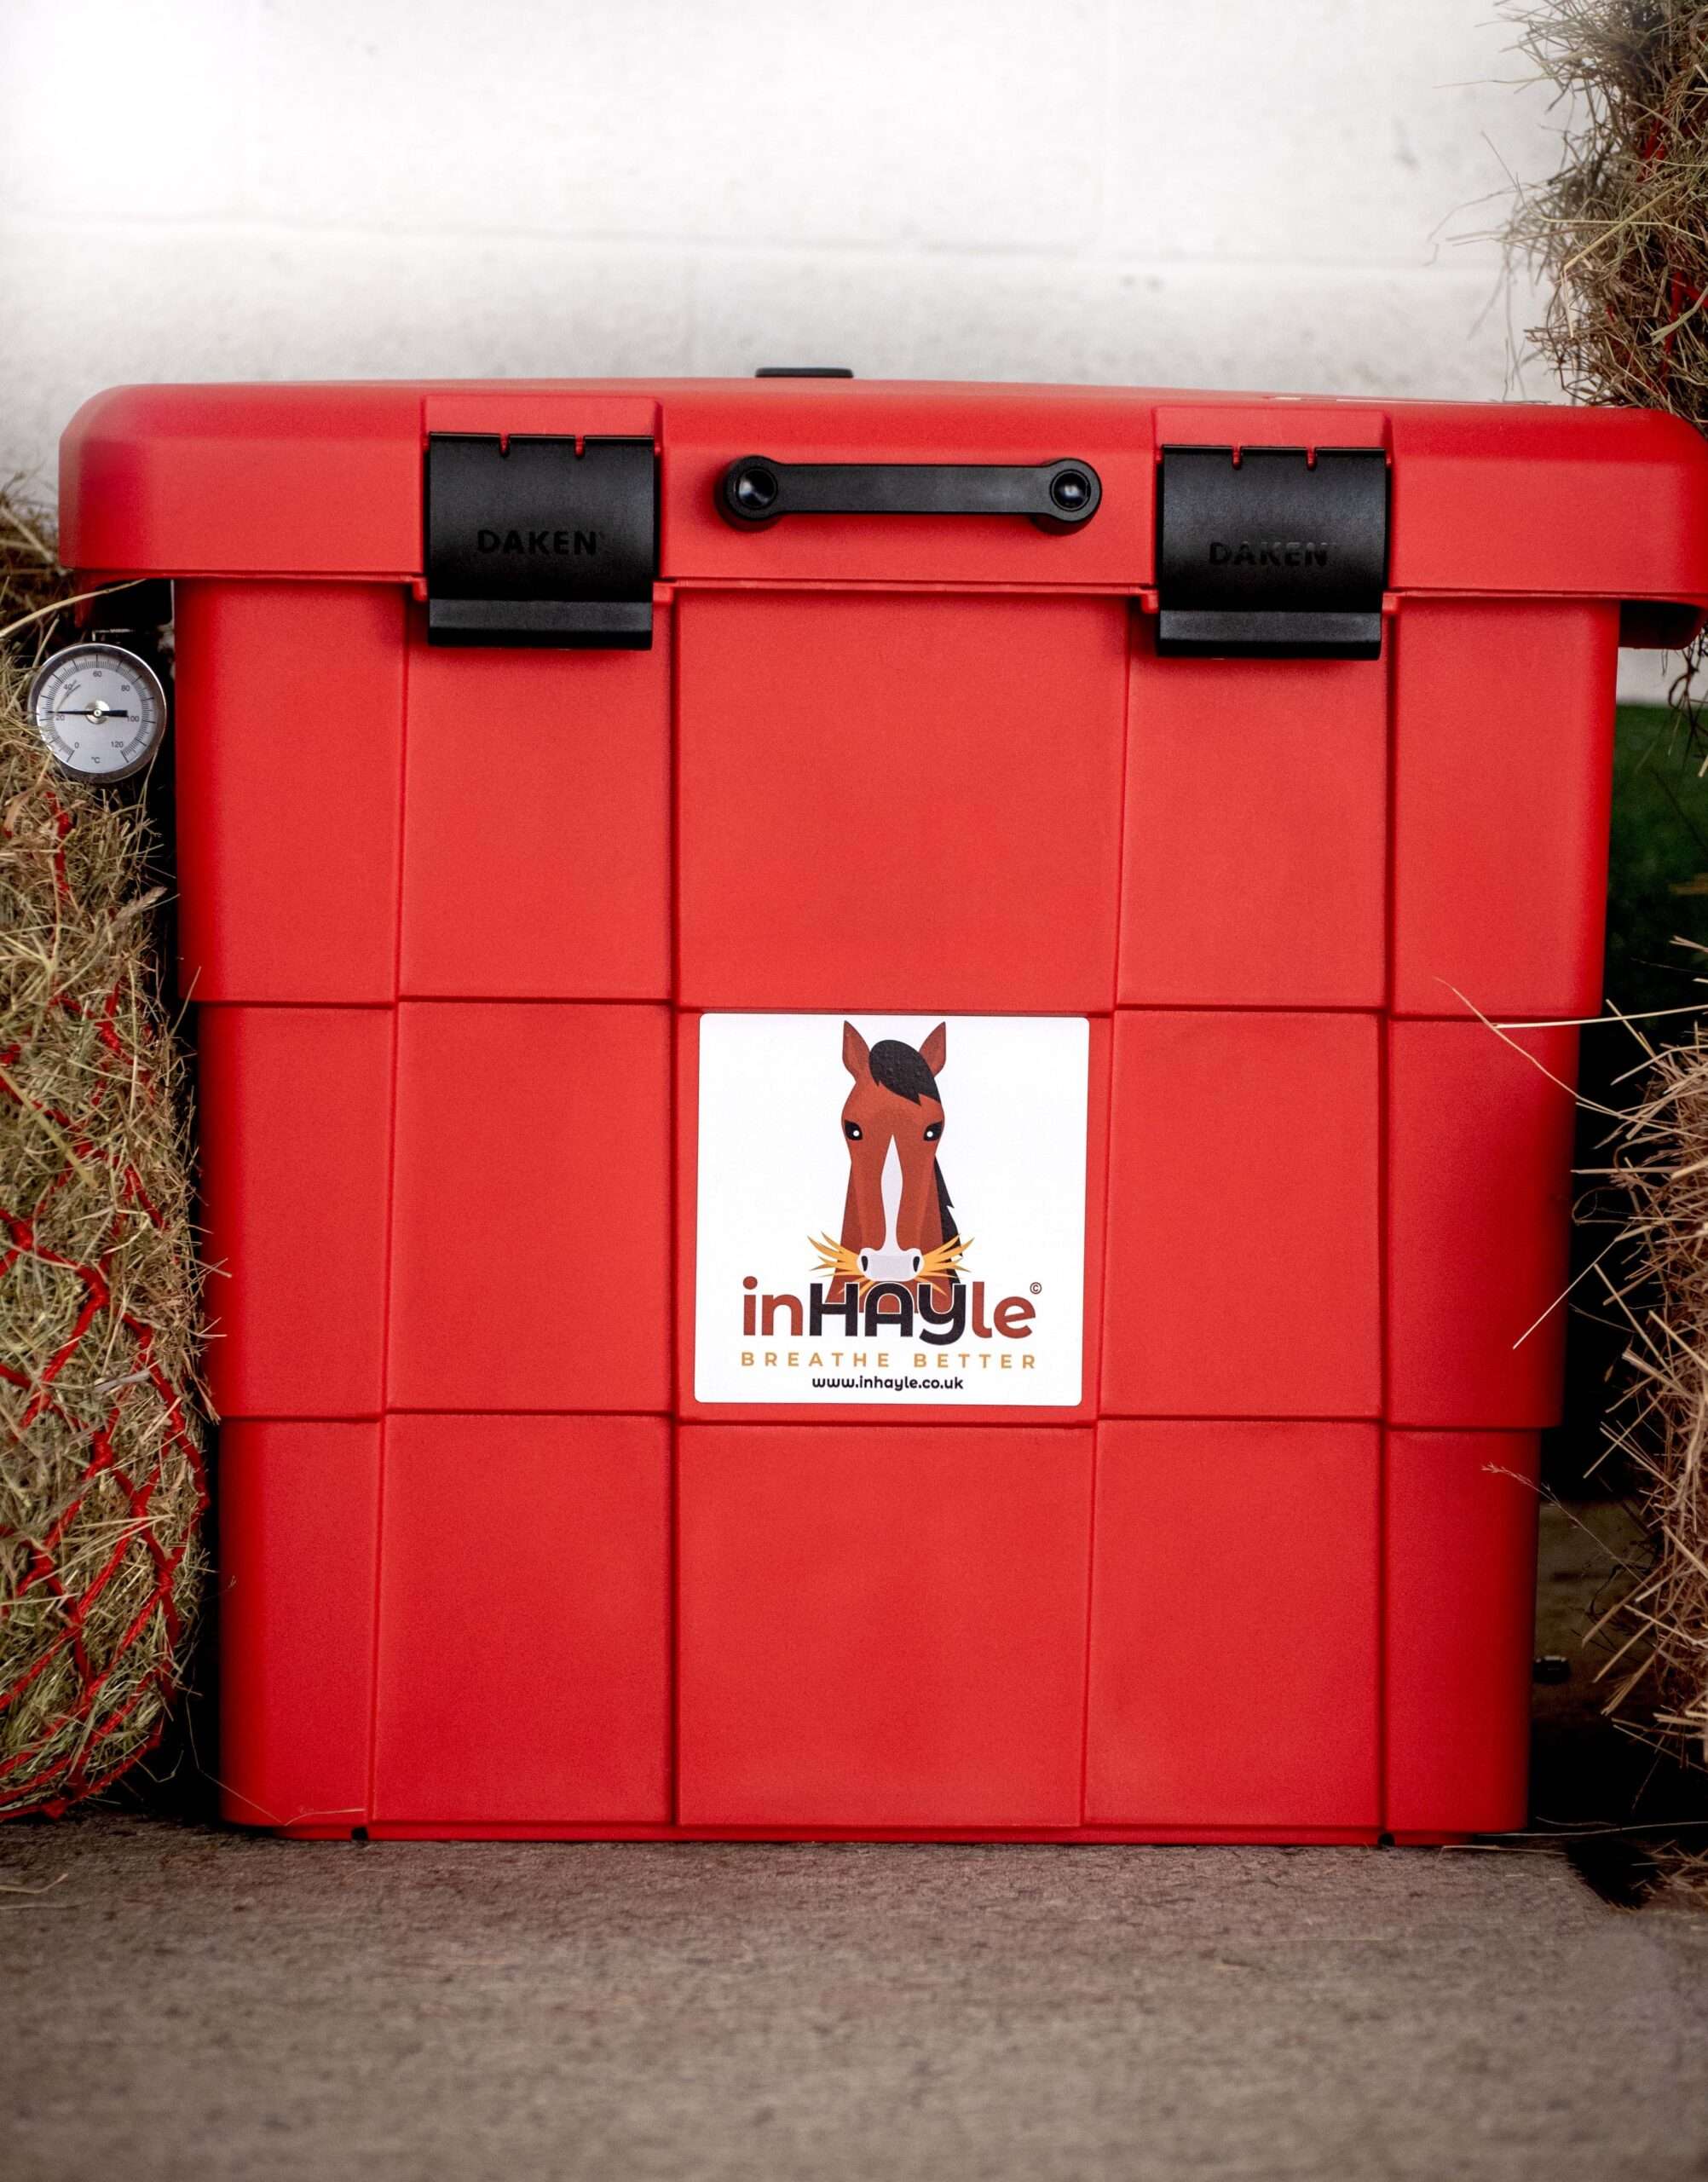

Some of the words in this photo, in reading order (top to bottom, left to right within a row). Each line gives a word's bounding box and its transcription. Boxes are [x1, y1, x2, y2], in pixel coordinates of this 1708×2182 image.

[476, 528, 597, 555] DAKEN
[1209, 541, 1328, 567] DAKEN
[741, 1351, 890, 1368] BREATHE
[914, 1353, 1036, 1370] BETTER
[812, 1375, 964, 1391] www.inhayle.co.uk
